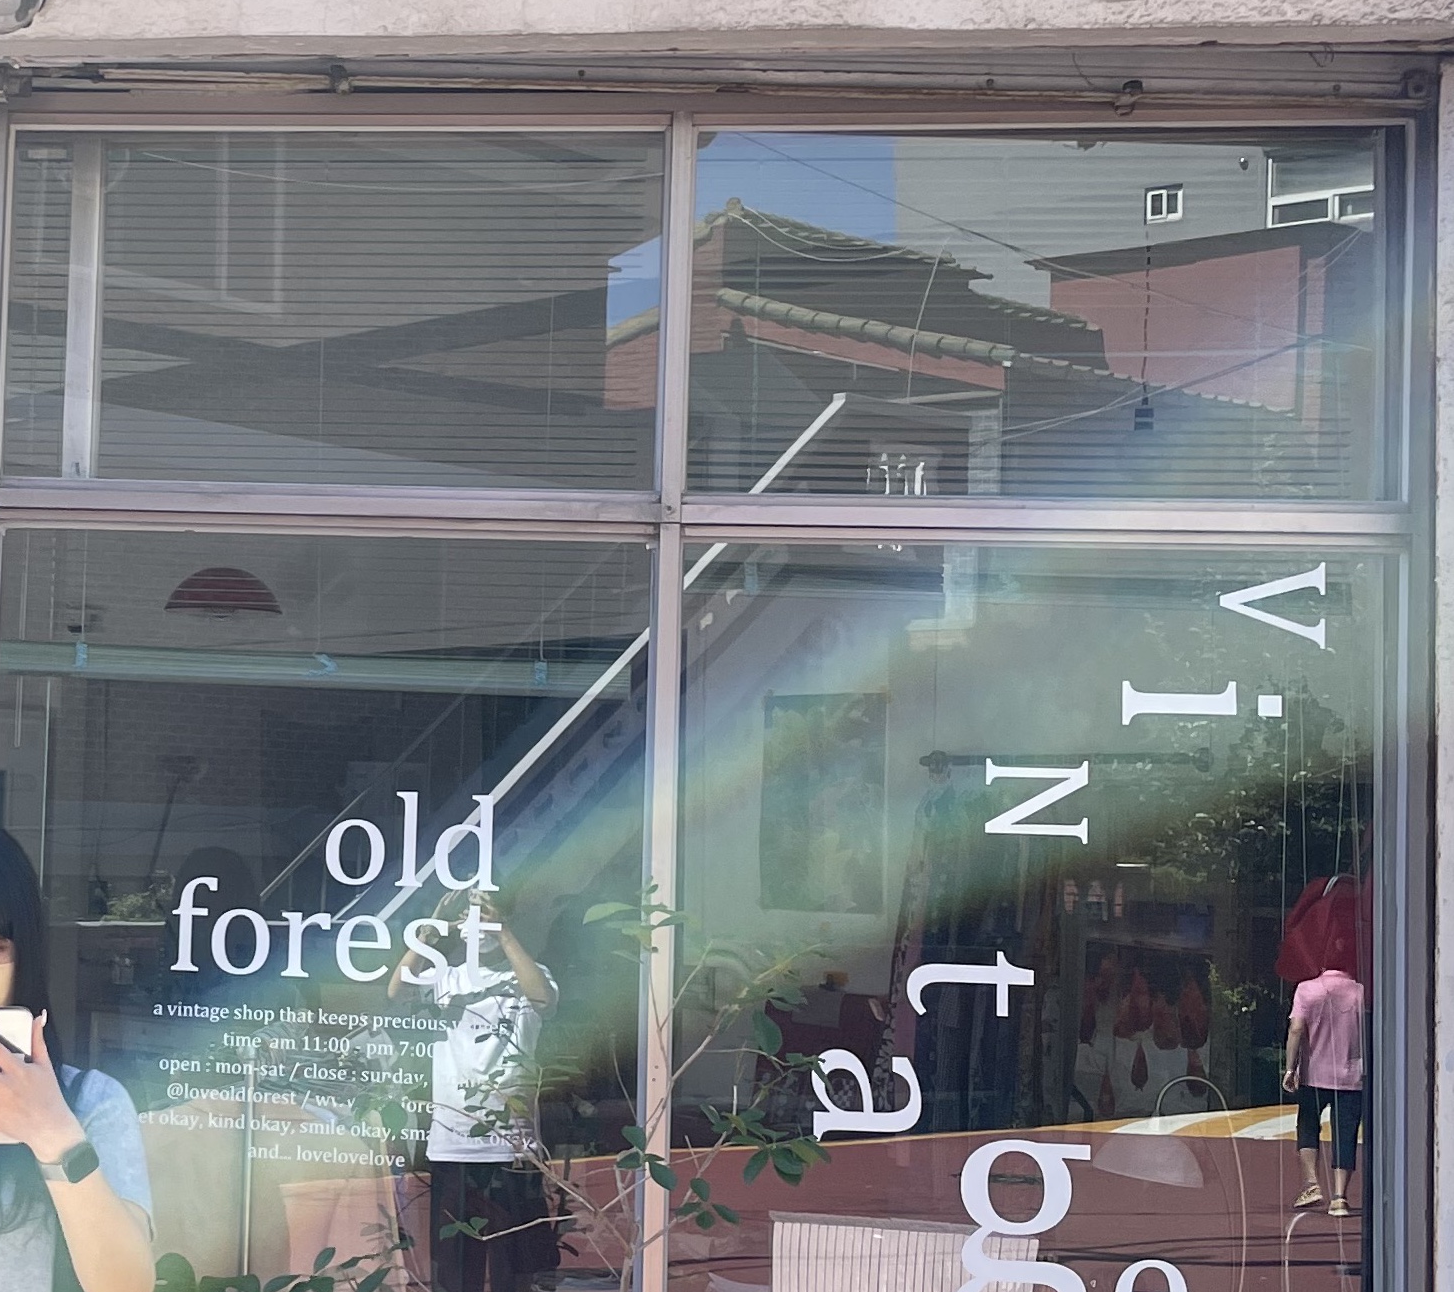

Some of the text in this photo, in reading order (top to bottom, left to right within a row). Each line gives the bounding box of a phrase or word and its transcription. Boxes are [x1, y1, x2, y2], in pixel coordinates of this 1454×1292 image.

[325, 790, 500, 892] old
[169, 875, 503, 988] forest
[152, 1003, 163, 1016] a
[166, 1001, 230, 1023] vintage
[233, 1004, 275, 1025] shop
[279, 1007, 315, 1024] that
[318, 1009, 369, 1028] keeps
[372, 1014, 447, 1032] precious
[223, 1032, 262, 1048] time
[269, 1037, 296, 1050] am
[301, 1035, 350, 1053] 11:00
[366, 1043, 394, 1058] pm
[159, 1058, 201, 1075] open
[215, 1061, 286, 1078] mon-sat
[303, 1063, 347, 1081] close
[166, 1082, 297, 1106] @loveoldforest
[158, 1112, 203, 1131] okay,
[208, 1112, 245, 1130] kind
[249, 1115, 296, 1136] okay,
[299, 1118, 346, 1136] smile
[350, 1120, 396, 1143] okay,
[248, 1144, 406, 1168] and... lovelovelove
